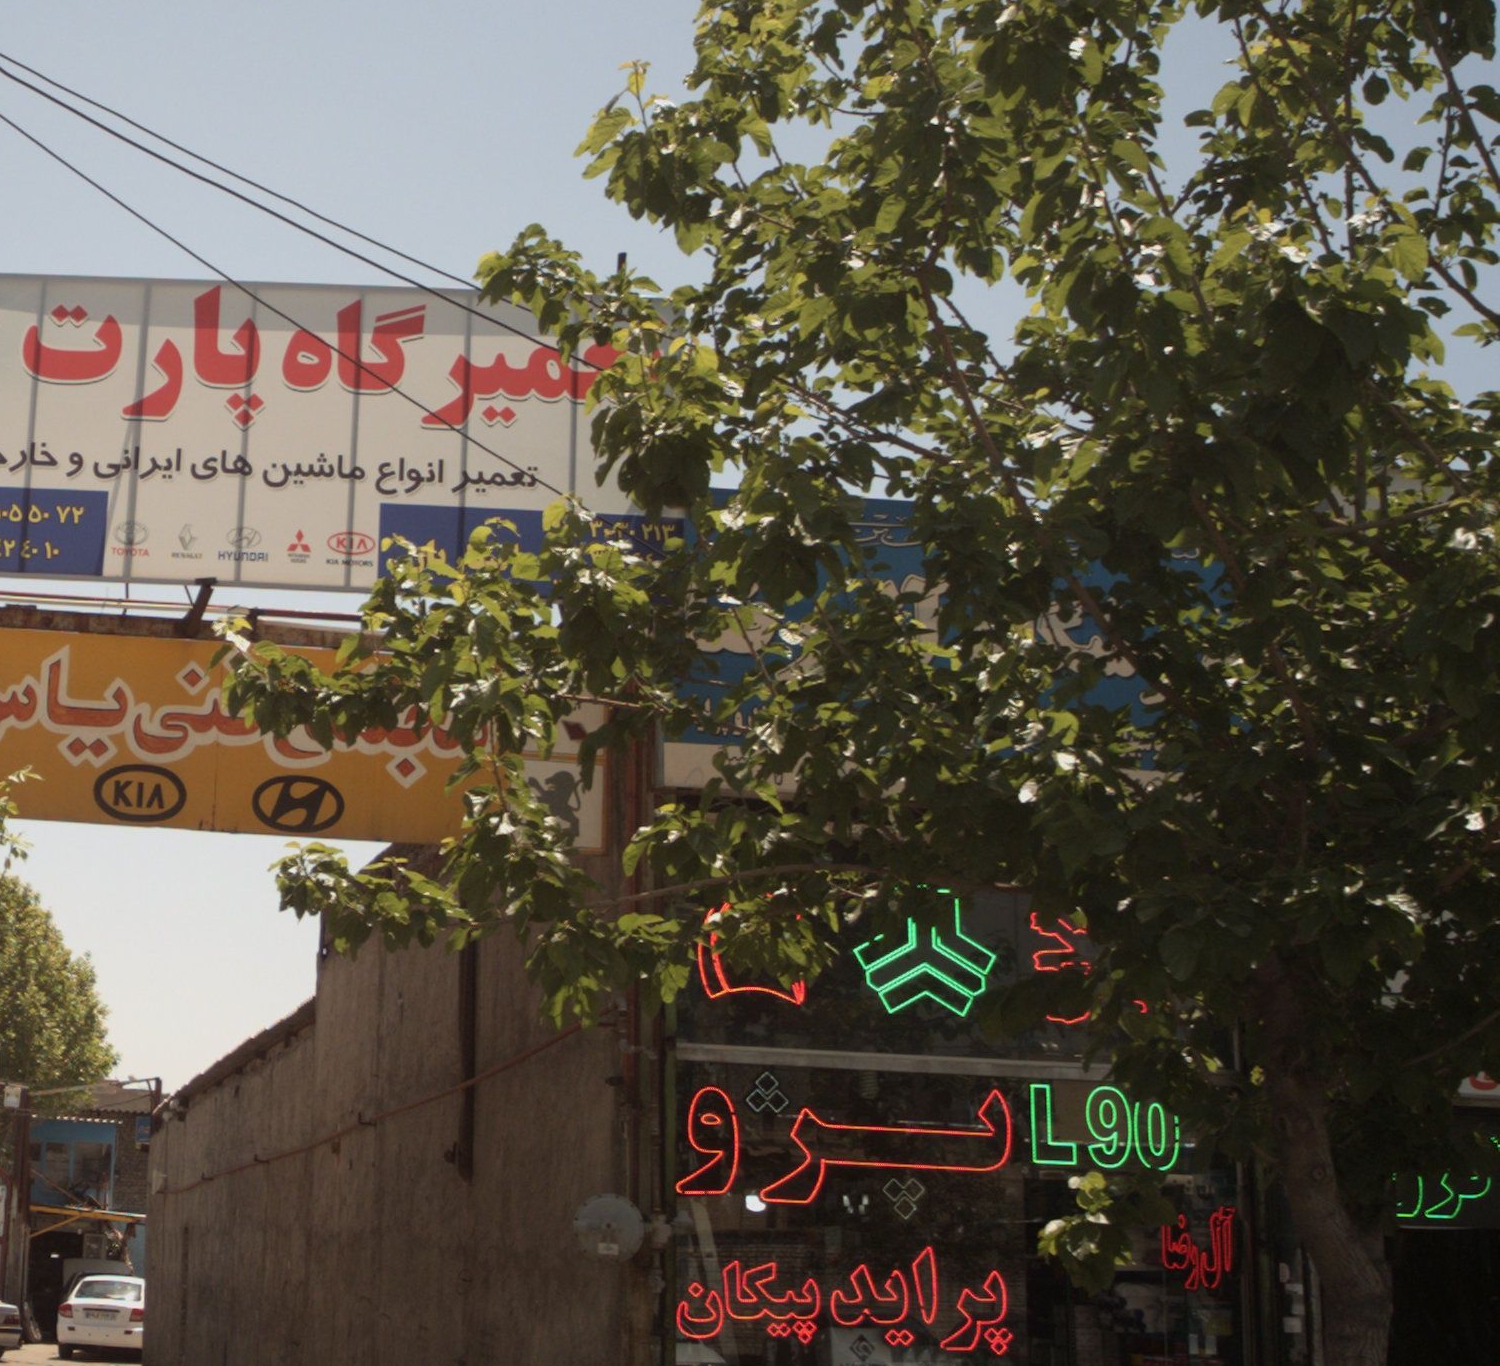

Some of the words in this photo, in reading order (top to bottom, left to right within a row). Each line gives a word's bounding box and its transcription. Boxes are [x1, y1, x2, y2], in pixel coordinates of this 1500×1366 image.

[20, 285, 267, 428] پارت
[280, 298, 664, 429] عمیرگاه
[65, 450, 85, 478] و
[92, 444, 184, 480] ایرانی
[189, 445, 254, 482] های
[262, 452, 366, 490] ماشین
[374, 457, 445, 495] انواع
[451, 464, 539, 494] تعمیر
[111, 546, 150, 557] TOYOTA
[217, 550, 269, 563] HYUNDAI
[341, 558, 374, 567] MOTORS
[112, 779, 166, 811] KIA
[1029, 1082, 1181, 1172] L90
[675, 1257, 824, 1347] پیکان
[827, 1245, 1015, 1356] پراید
